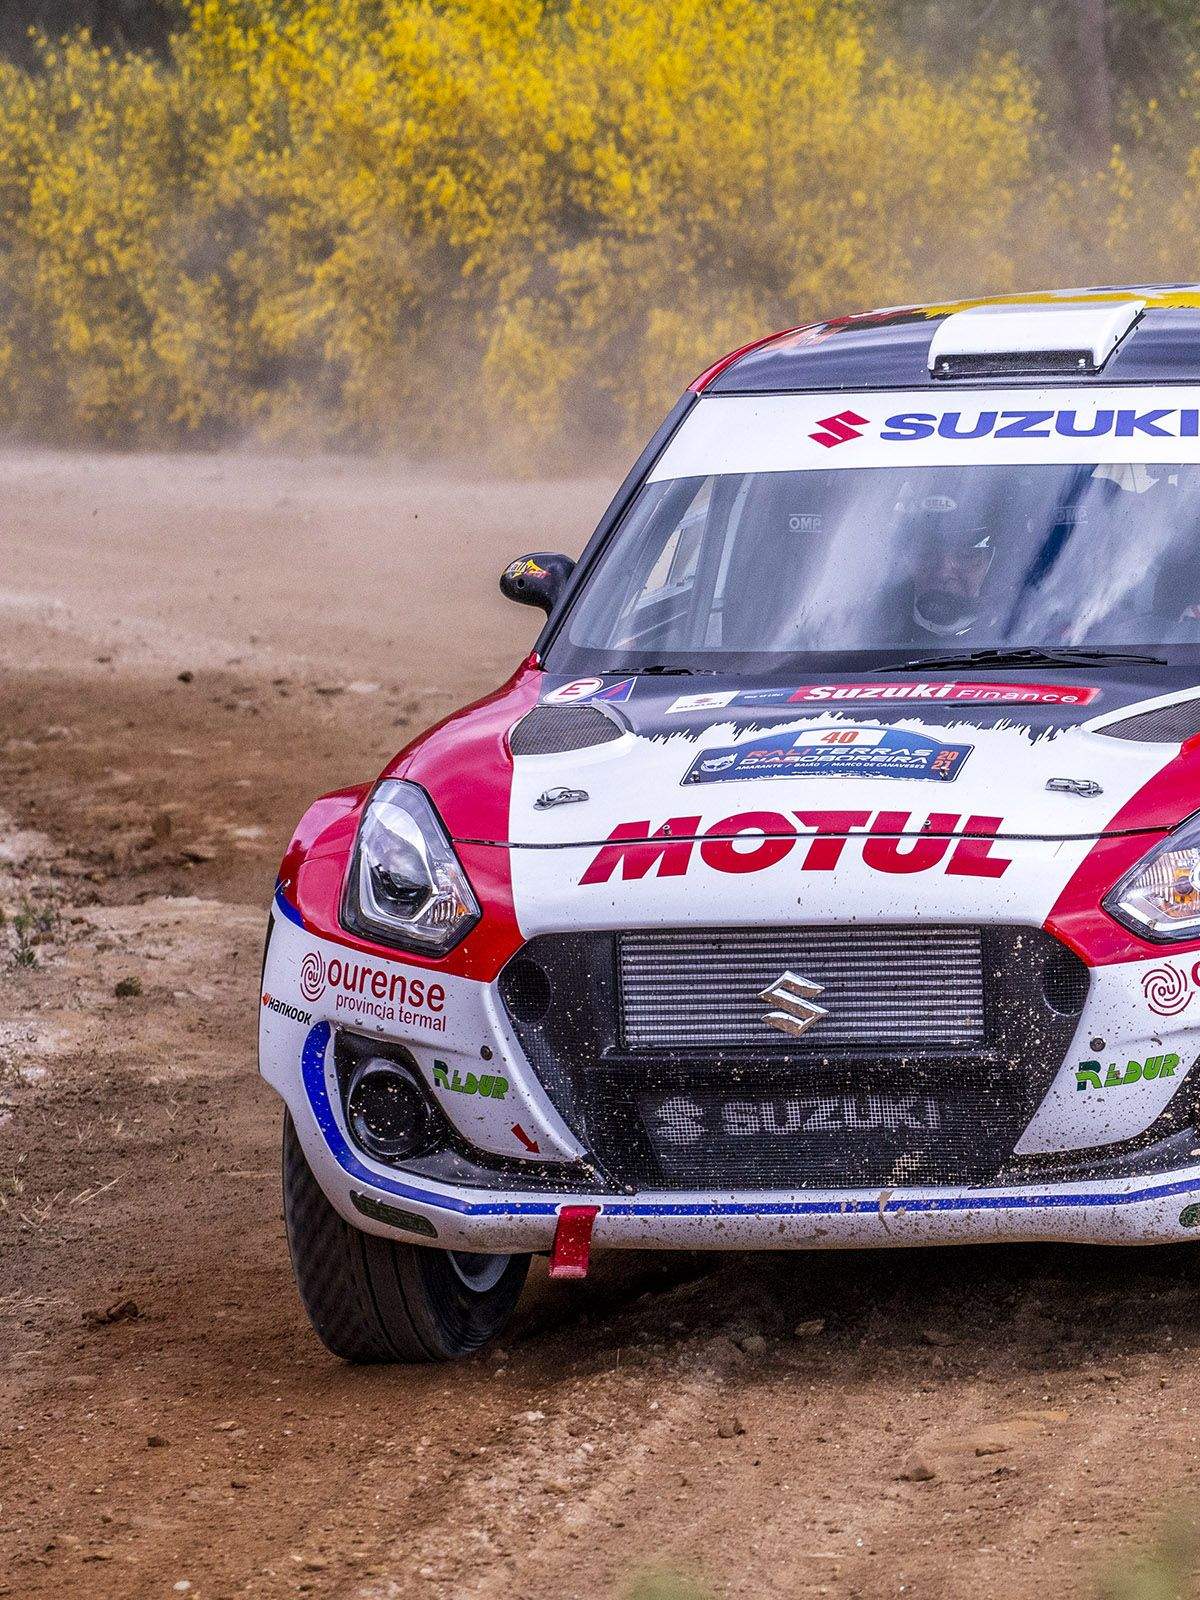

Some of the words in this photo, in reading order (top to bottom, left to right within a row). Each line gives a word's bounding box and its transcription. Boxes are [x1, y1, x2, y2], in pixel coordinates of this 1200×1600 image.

[879, 409, 1199, 440] SUZUKI
[789, 517, 821, 530] OMP
[558, 682, 596, 695] E
[803, 684, 956, 701] Suzuki
[956, 689, 1079, 704] Finance
[820, 731, 860, 744] 40
[746, 749, 811, 758] RALI
[815, 747, 933, 757] TERRAS
[937, 751, 959, 760] 20
[735, 763, 784, 771] AMARANTE
[578, 810, 1013, 886] MOTUL
[327, 958, 446, 1012] ourense
[336, 993, 394, 1020] provincia
[398, 1007, 446, 1032] termal
[721, 1095, 941, 1136] SUZUKI
